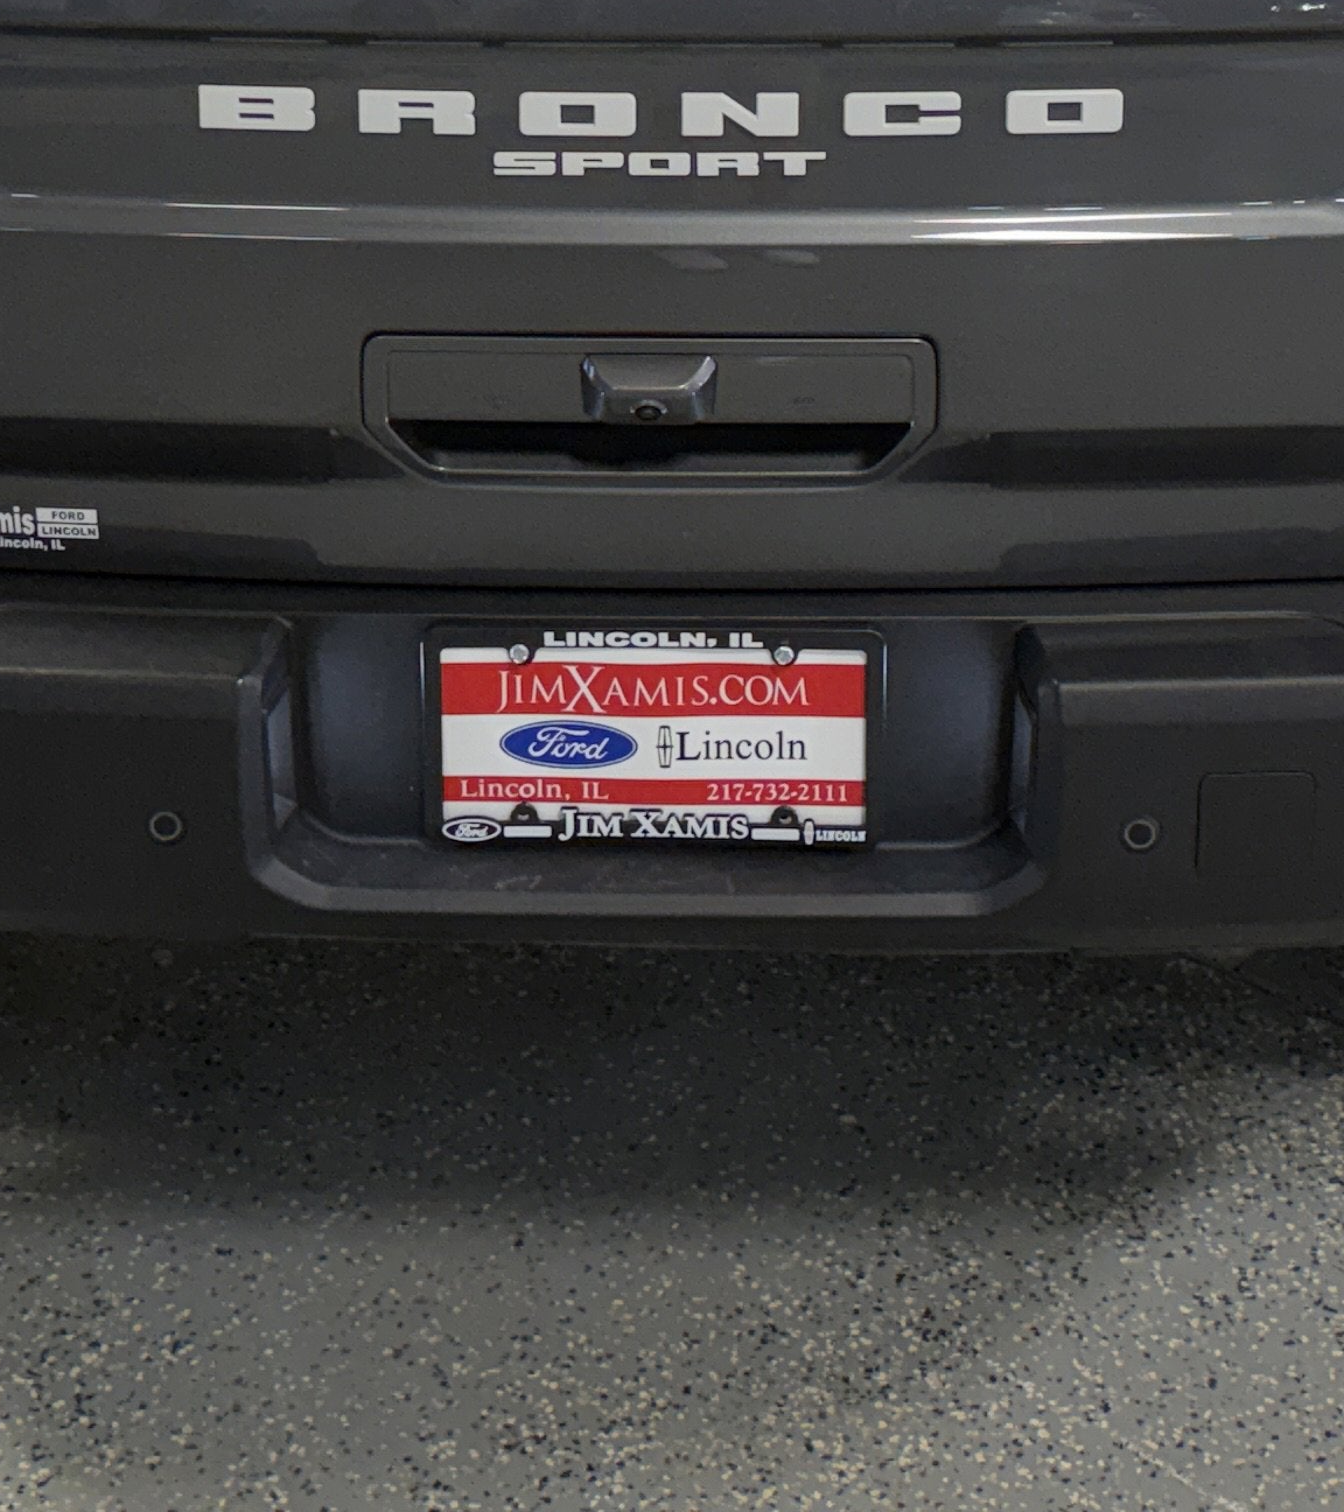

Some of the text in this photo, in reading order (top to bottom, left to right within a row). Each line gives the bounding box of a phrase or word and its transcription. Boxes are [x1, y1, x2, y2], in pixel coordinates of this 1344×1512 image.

[199, 84, 1123, 137] BRONCO
[493, 151, 827, 177] SPORT
[51, 510, 86, 521] FORD
[42, 526, 97, 537] LINCOLN
[51, 539, 66, 551] IL
[543, 631, 764, 648] LINCOLN, IL
[496, 665, 810, 713] JIMXAMIS.COM
[527, 726, 609, 760] Ford
[676, 731, 807, 761] Lincoln
[460, 779, 609, 800] Lincoln, IL
[706, 783, 848, 803] 217-732-2111
[558, 807, 750, 841] JIM XAMIS
[816, 830, 867, 842] LINCOLN
